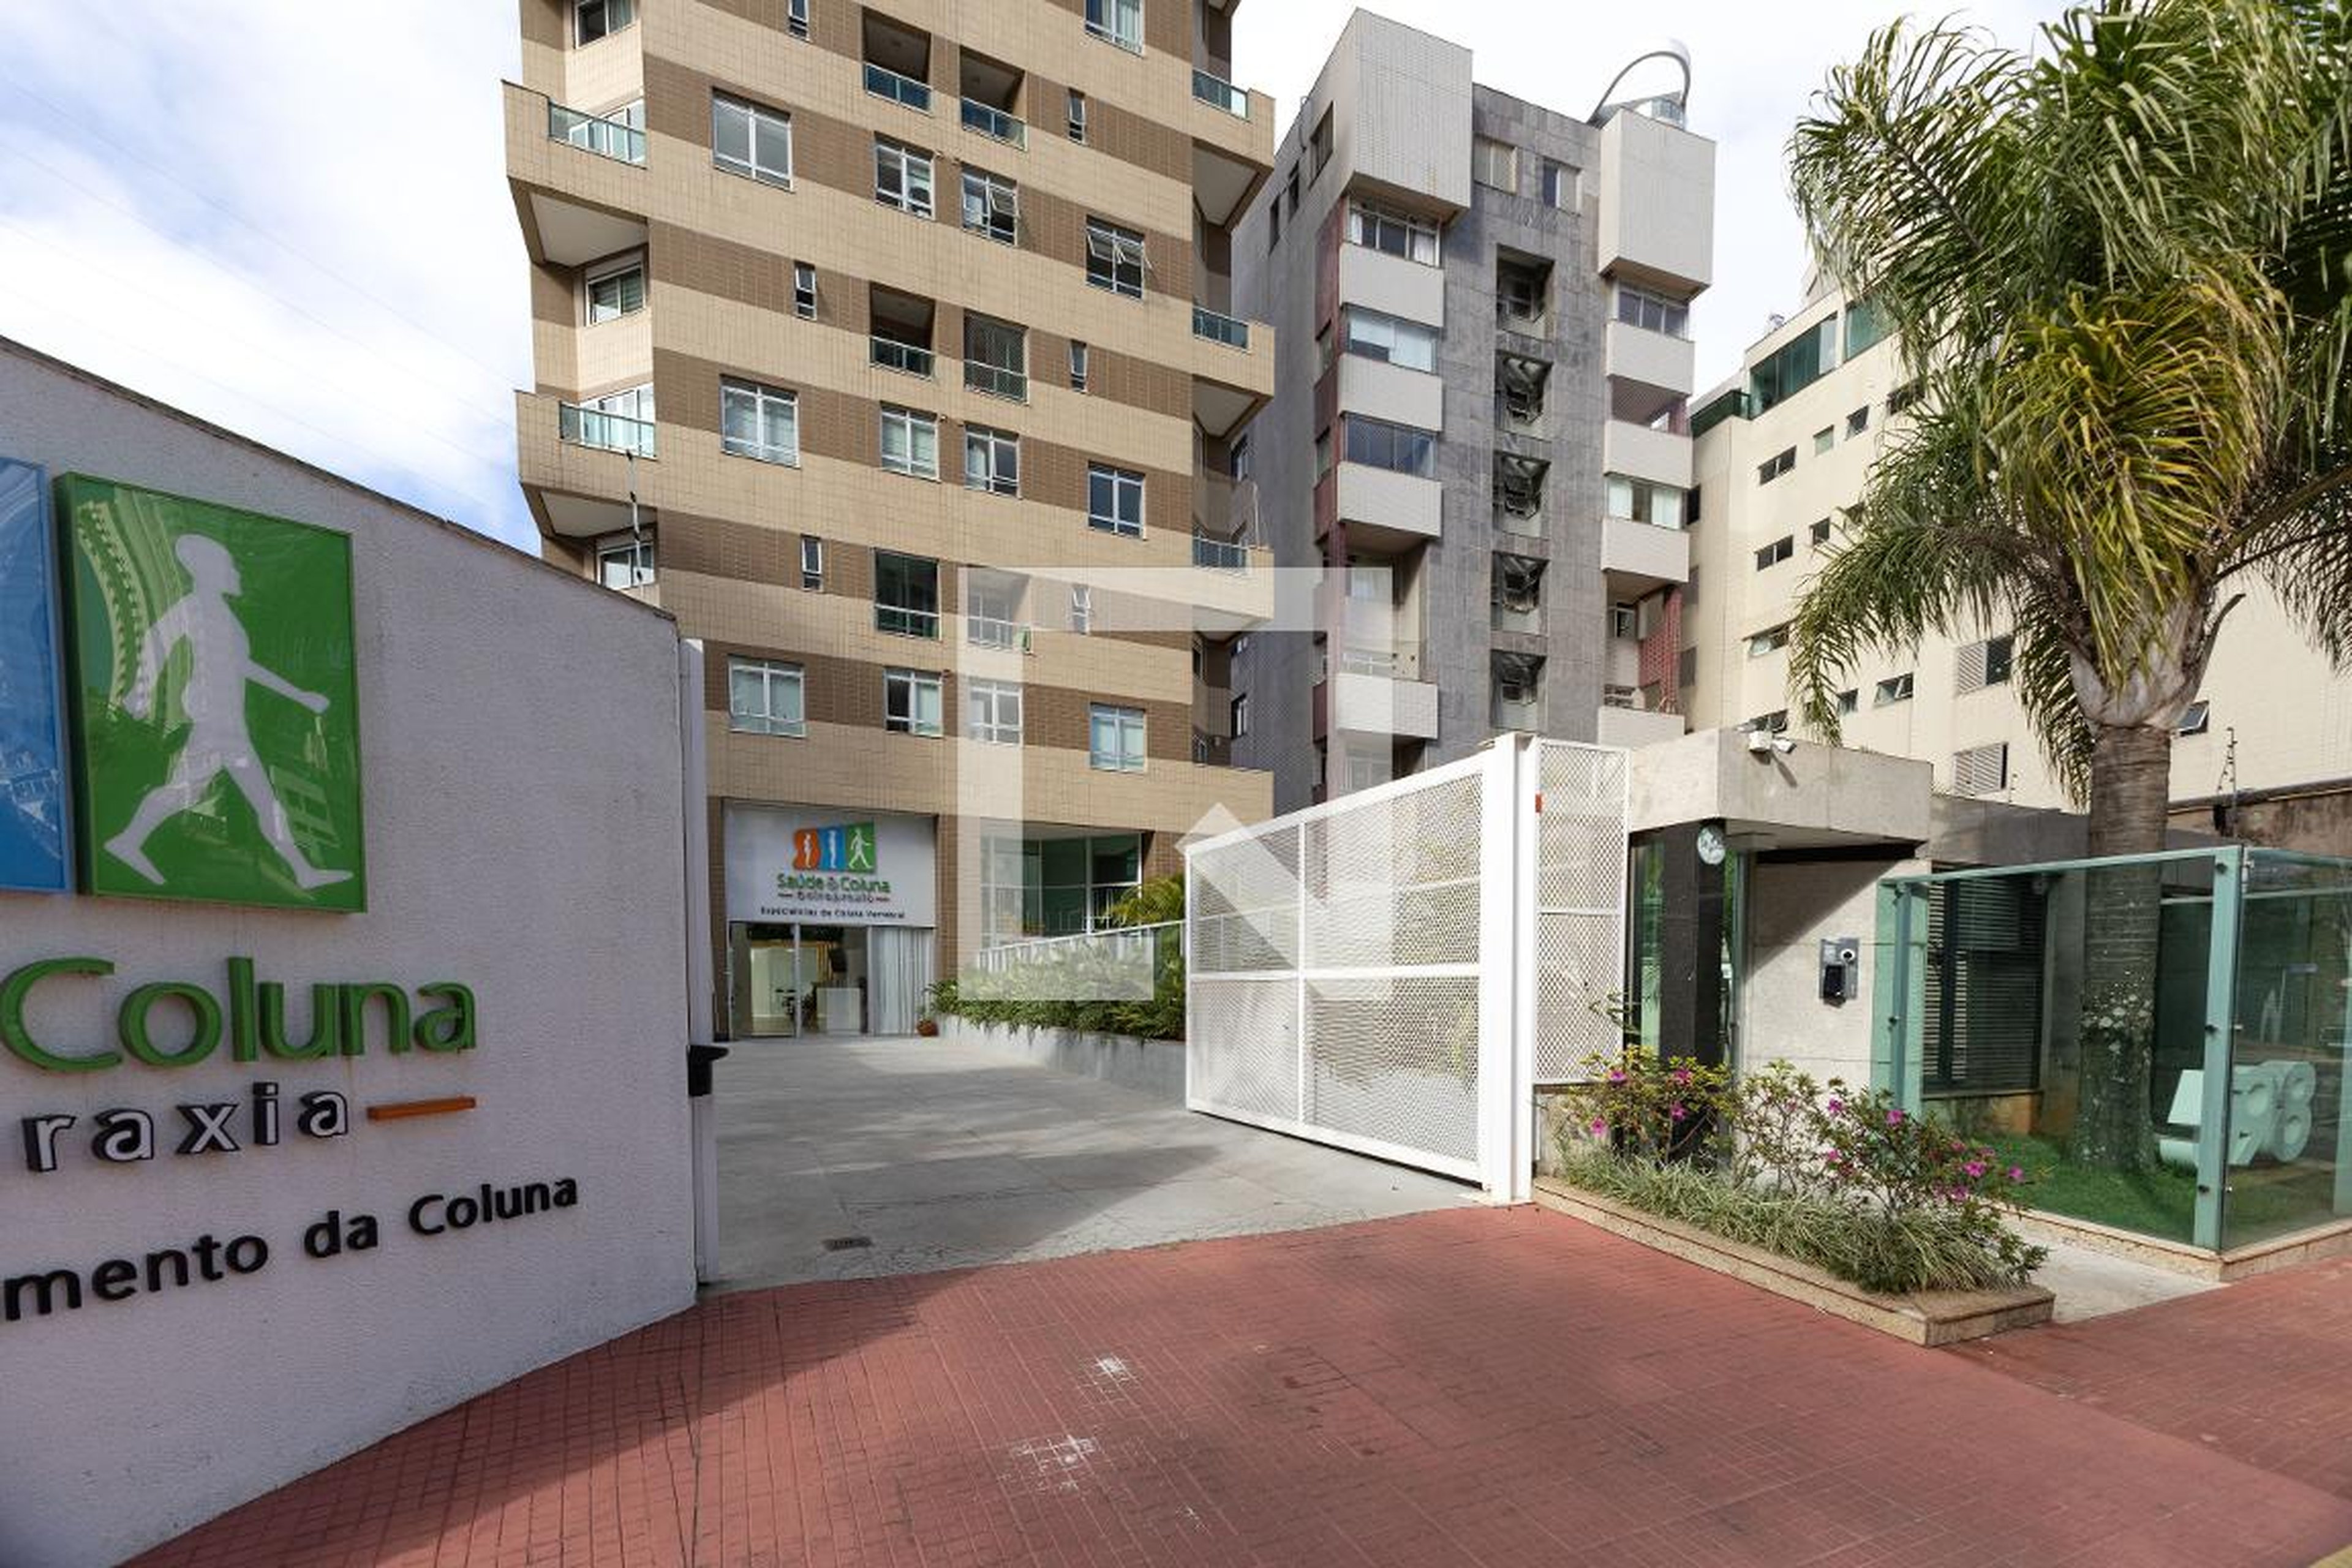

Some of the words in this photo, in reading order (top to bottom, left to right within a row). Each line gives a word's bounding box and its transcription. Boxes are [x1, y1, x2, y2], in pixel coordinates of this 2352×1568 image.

[840, 876, 891, 893] Coluna
[0, 957, 477, 1072] Coluna
[21, 1081, 349, 1172] raxia
[2, 1234, 269, 1321] mento
[304, 1210, 378, 1258] da
[409, 1177, 577, 1236] Coluna
